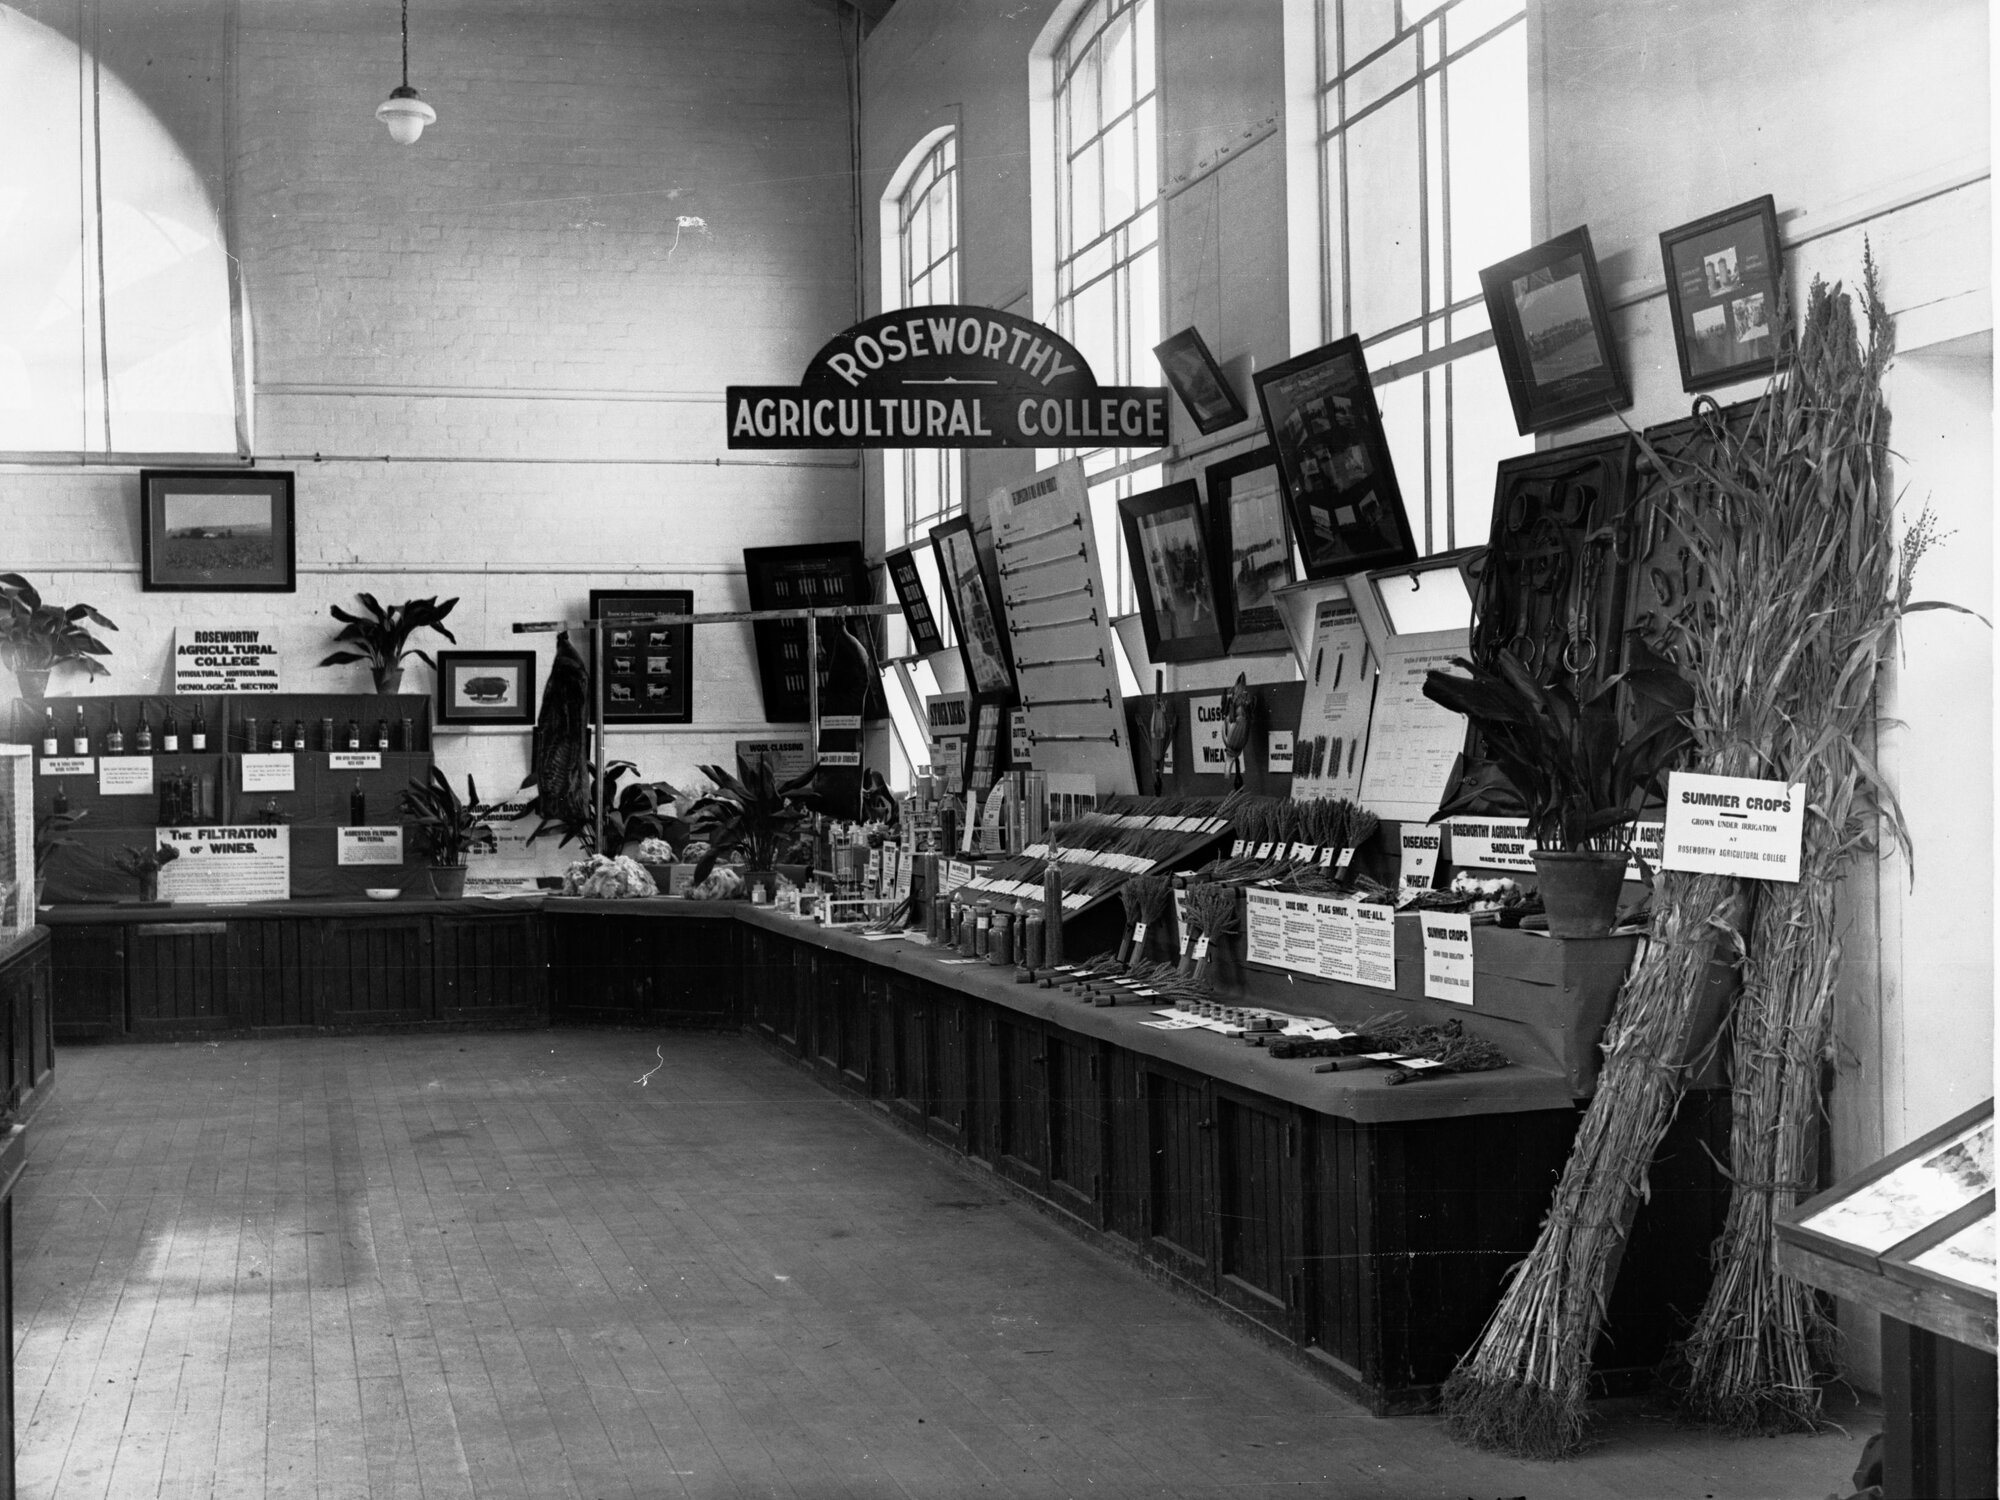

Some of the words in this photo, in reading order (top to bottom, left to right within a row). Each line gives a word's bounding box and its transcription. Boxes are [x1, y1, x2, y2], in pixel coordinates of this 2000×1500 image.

[826, 317, 1077, 388] ROSEWORTHY
[732, 398, 992, 438] AGRICULTURAL
[1017, 398, 1164, 438] COLLEGE
[195, 630, 259, 643] ROSEWORTHY
[177, 645, 278, 655] AGRICULTURAL
[194, 657, 260, 666] COLLEGE
[1198, 706, 1226, 722] CLASS
[1682, 792, 1740, 808] SUMMER
[1746, 797, 1791, 813] CROPS
[1453, 824, 1489, 838] ROSEWORTHY
[1491, 825, 1536, 840] AGRICULTU
[1691, 818, 1714, 826] GROWN
[1718, 820, 1738, 829] UNDER
[1741, 823, 1777, 832] IRRIGATION
[169, 830, 192, 840] THE
[198, 828, 277, 840] FILTRATION
[190, 846, 203, 854] OF
[210, 843, 257, 854] WINES.
[1403, 836, 1439, 850] DISEASES
[1491, 842, 1525, 854] SADDLERY
[1678, 845, 1716, 856] ROSEWORTHY
[1719, 848, 1759, 860] AGRICULTURAL
[1762, 853, 1787, 863] COLLEGE
[1416, 858, 1423, 866] OF
[1406, 874, 1430, 888] WHEAT
[1318, 904, 1331, 914] FLAG
[1427, 927, 1447, 940] SUMMER
[1448, 929, 1468, 942] CROPS
